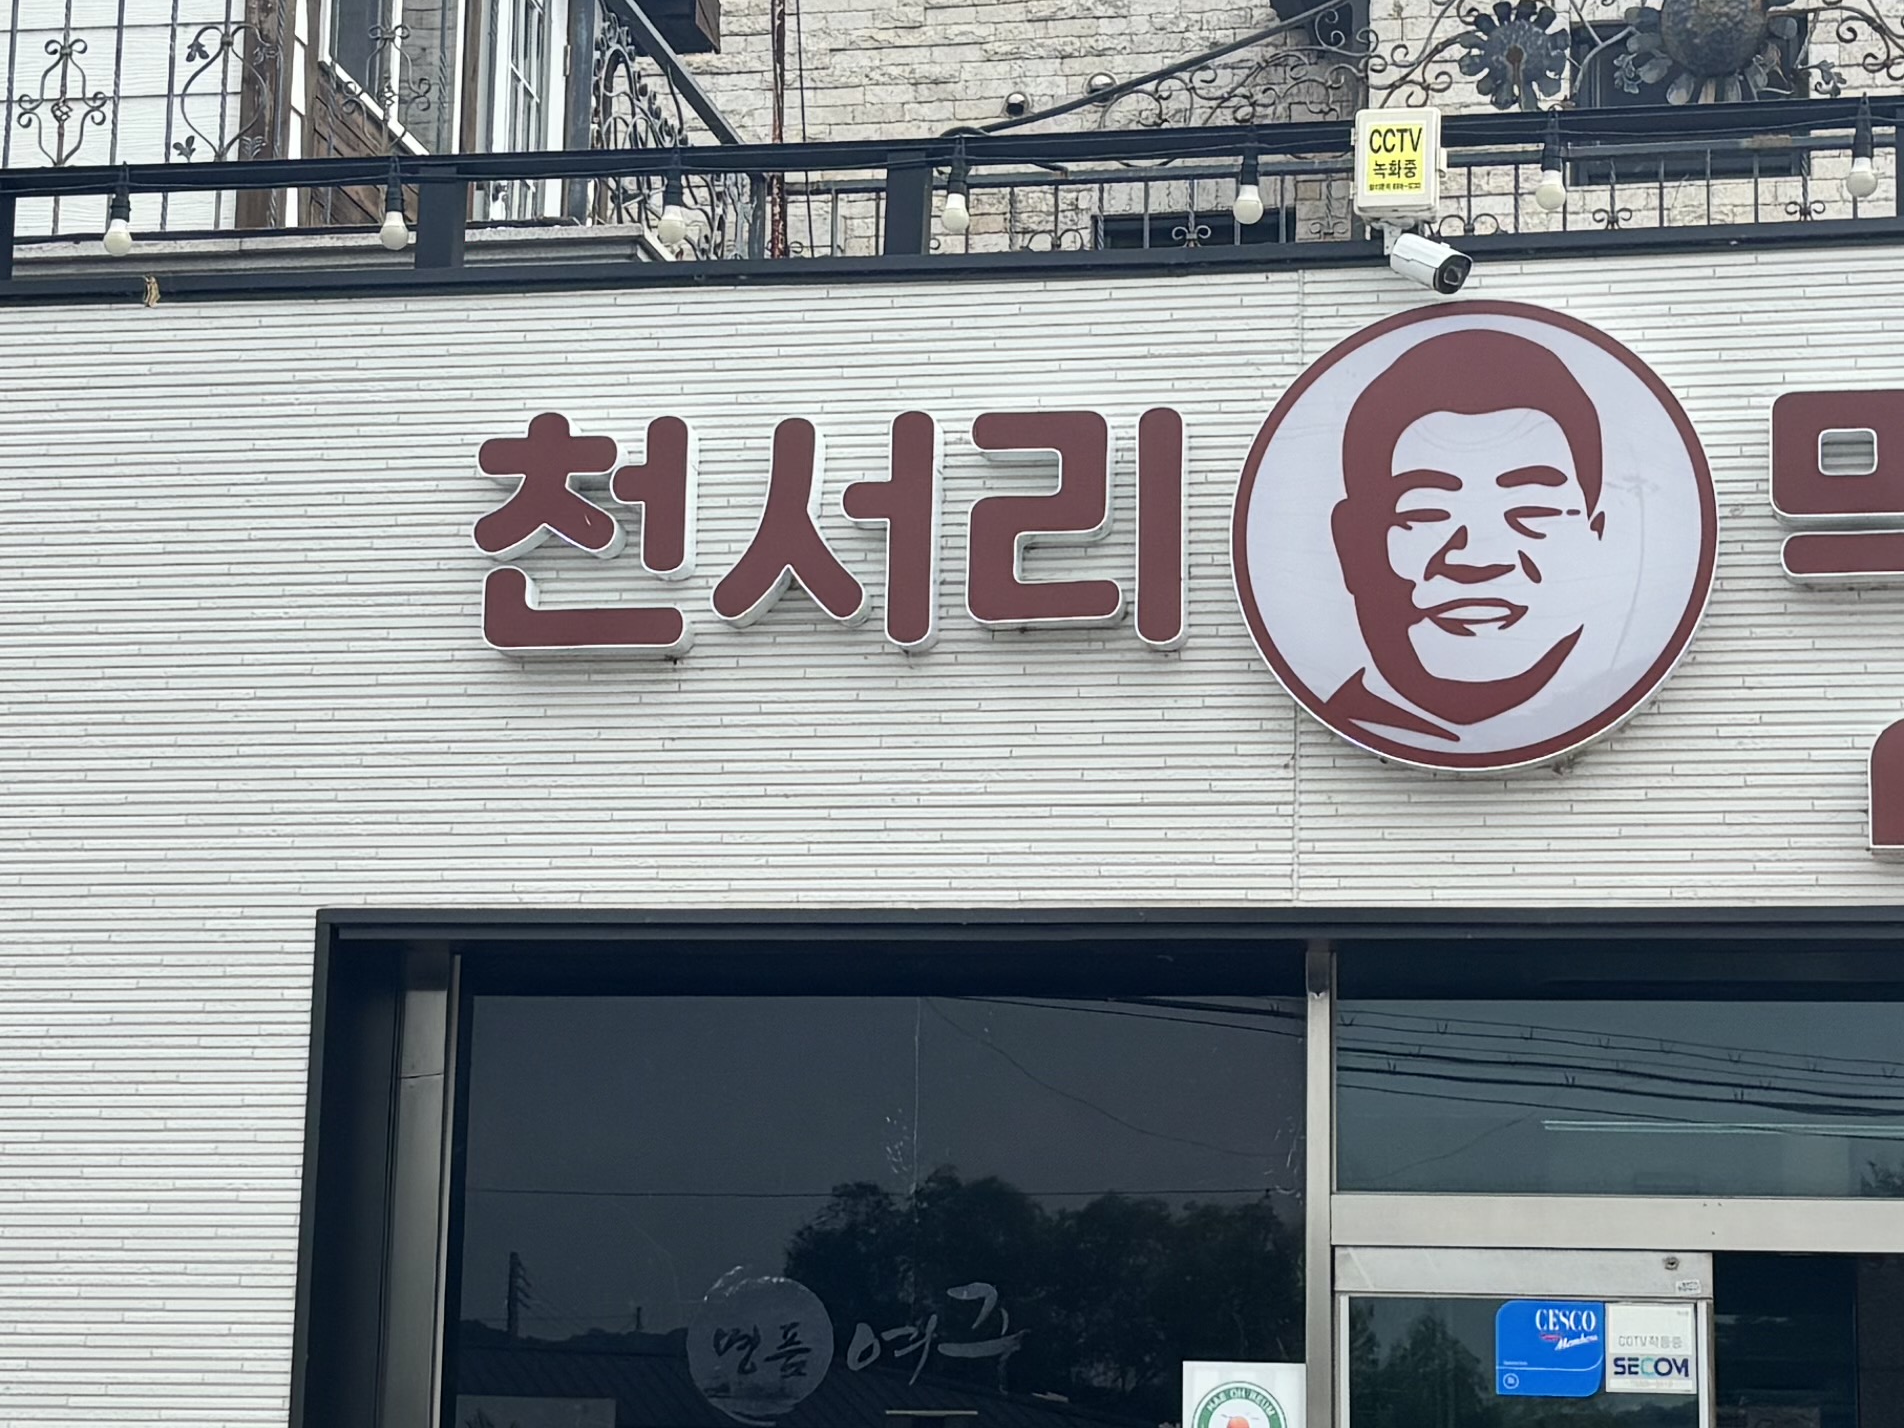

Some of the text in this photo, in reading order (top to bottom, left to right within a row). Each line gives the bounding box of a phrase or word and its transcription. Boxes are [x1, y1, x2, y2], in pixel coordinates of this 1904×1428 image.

[1369, 128, 1422, 153] CCTV
[1373, 159, 1417, 180] 녹화중
[472, 408, 1187, 654] 천서리
[1535, 1308, 1596, 1332] CESCO
[1613, 1357, 1689, 1377] SECOM
